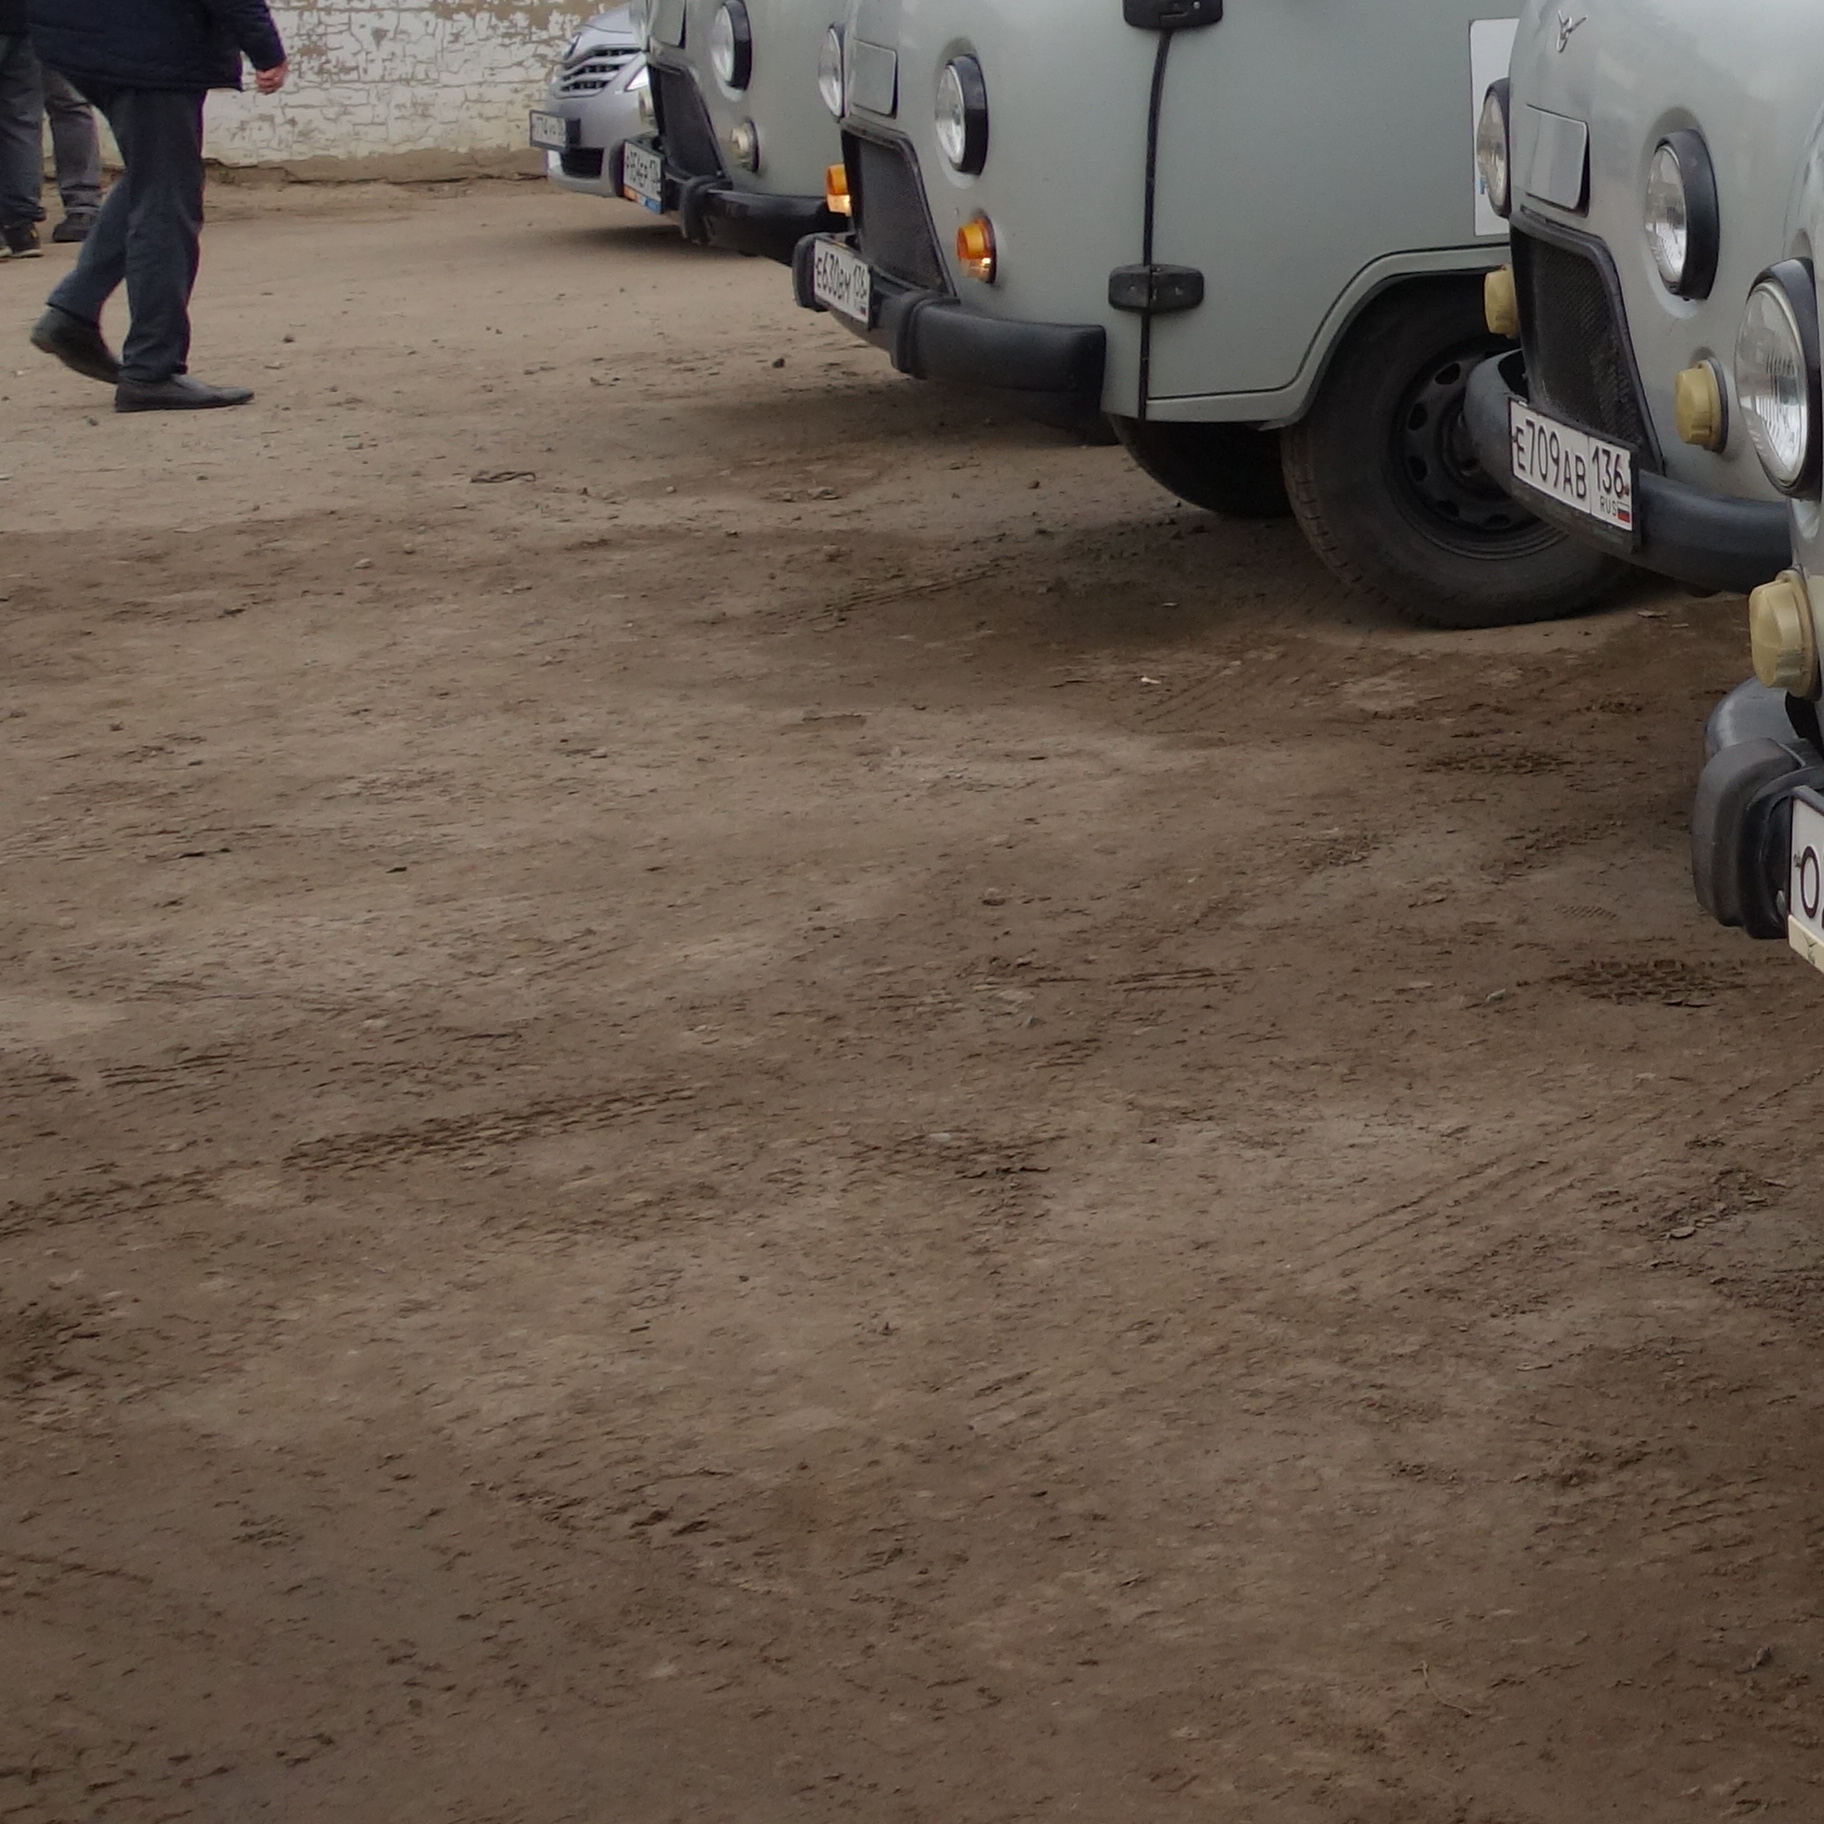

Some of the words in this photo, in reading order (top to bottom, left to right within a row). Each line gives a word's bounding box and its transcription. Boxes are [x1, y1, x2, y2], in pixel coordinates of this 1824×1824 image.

[1515, 418, 1587, 503] Е709АВ
[1592, 445, 1625, 499] 136
[1600, 495, 1618, 517] RUS
